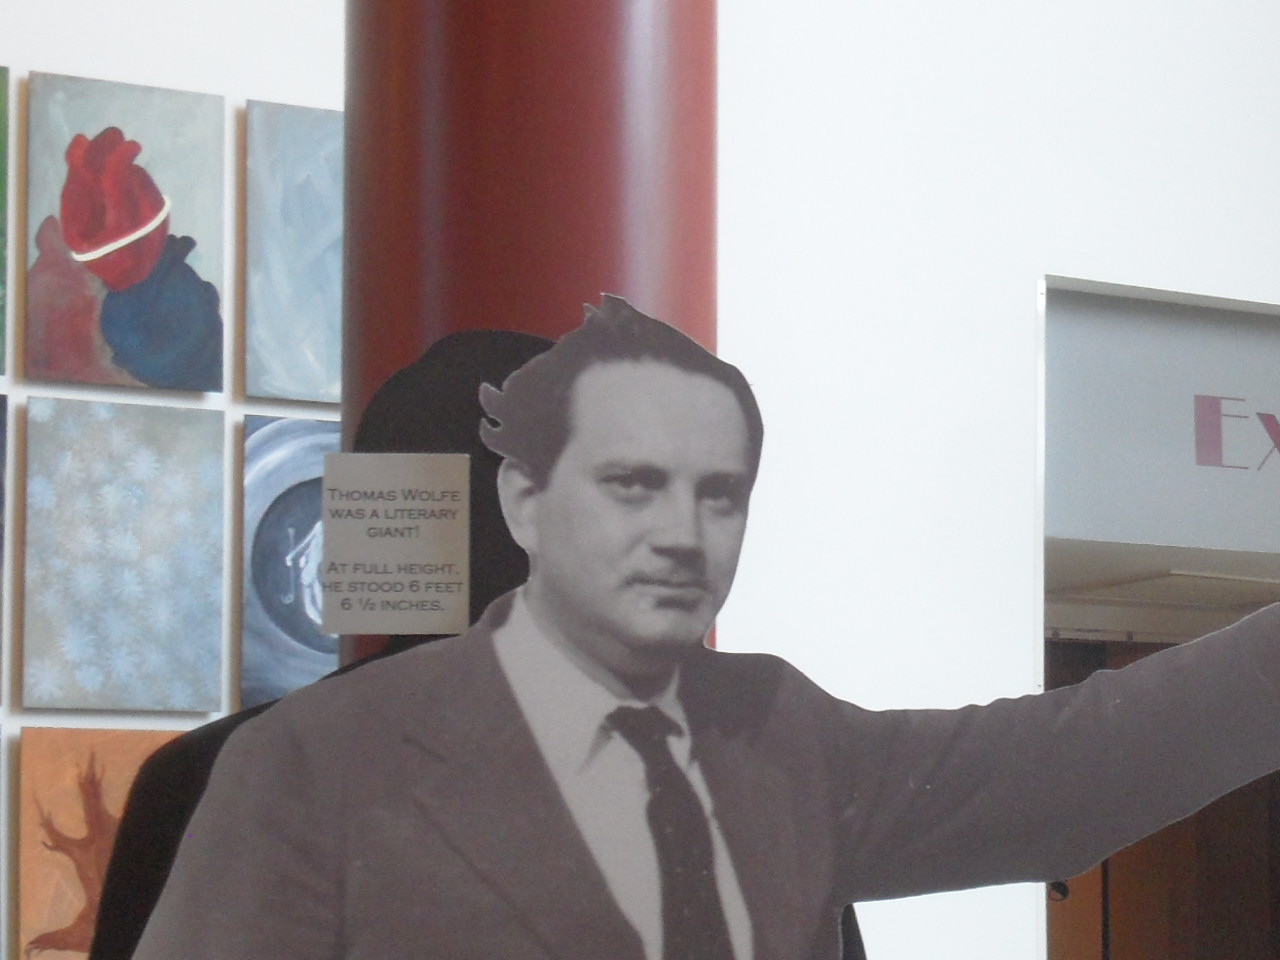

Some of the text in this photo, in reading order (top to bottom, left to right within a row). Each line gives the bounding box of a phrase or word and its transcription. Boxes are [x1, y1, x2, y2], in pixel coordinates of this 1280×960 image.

[327, 488, 461, 502] THOMAS WOLFE
[330, 508, 459, 520] WAS A LITERARY
[367, 526, 420, 538] GIANT!
[327, 562, 349, 575] AT
[352, 563, 393, 575] FULL
[323, 579, 463, 593] HE STOOD 6 FEET
[341, 599, 352, 612] 6
[380, 599, 445, 612] INCHES.
